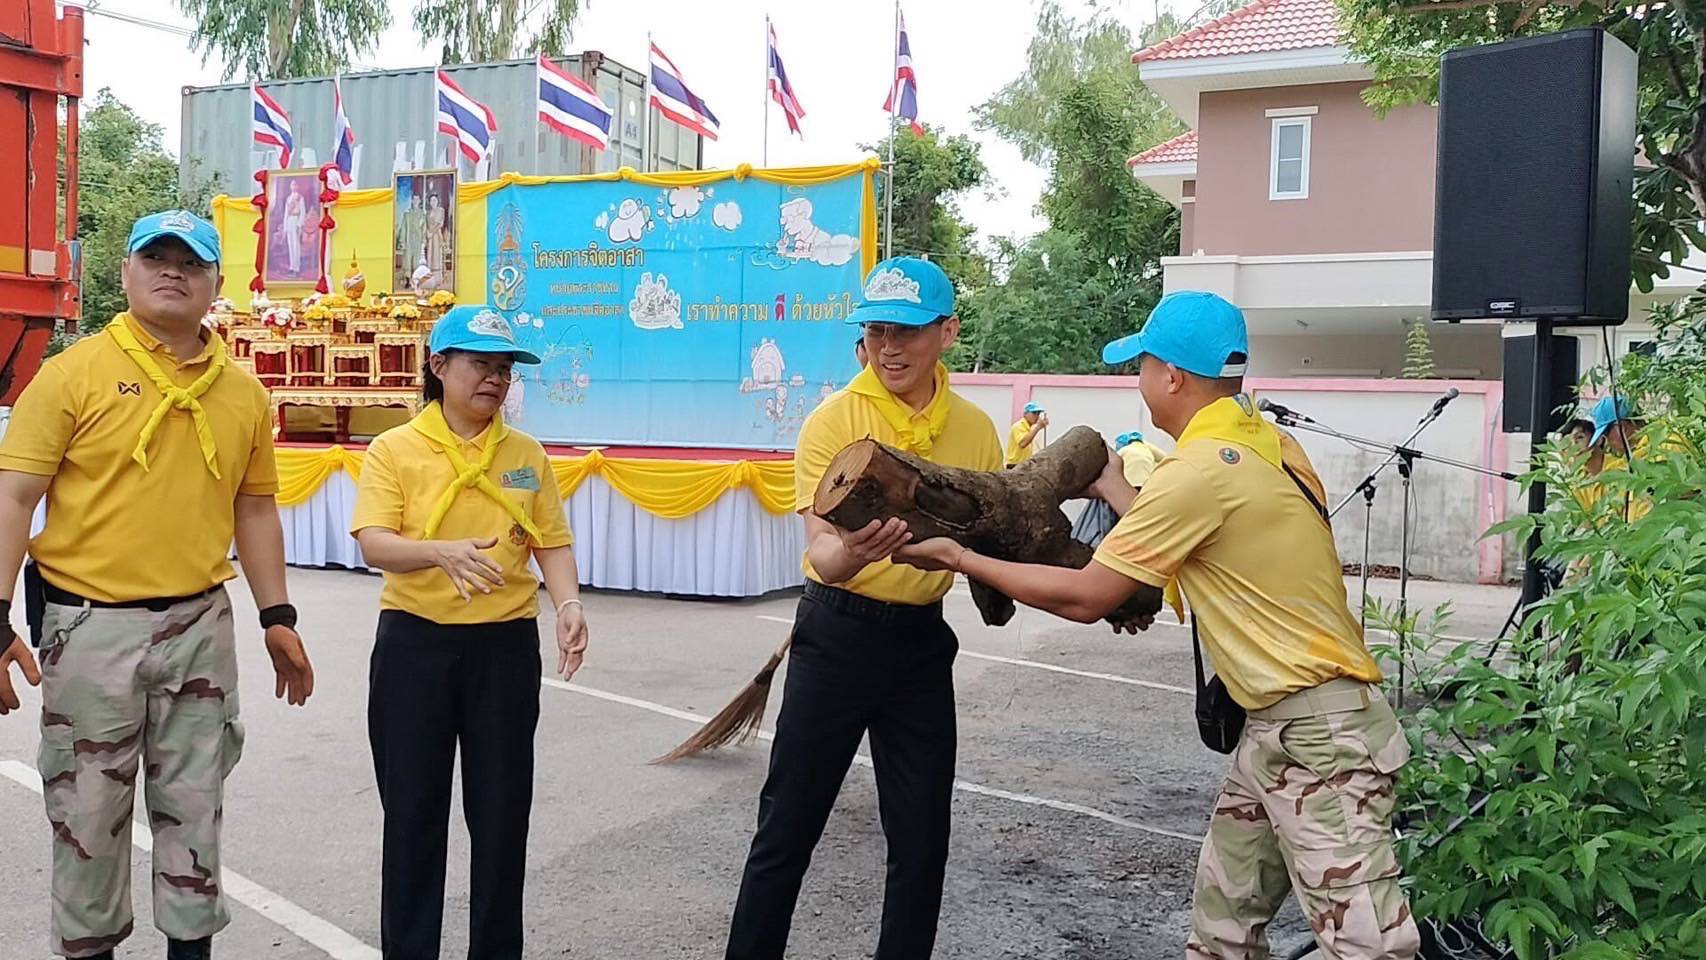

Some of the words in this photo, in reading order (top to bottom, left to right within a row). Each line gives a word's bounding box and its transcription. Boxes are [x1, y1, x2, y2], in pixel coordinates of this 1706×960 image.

[531, 241, 644, 268] โครงการจิตอาสา
[687, 296, 768, 321] เราทำความ
[774, 294, 785, 321] ดี
